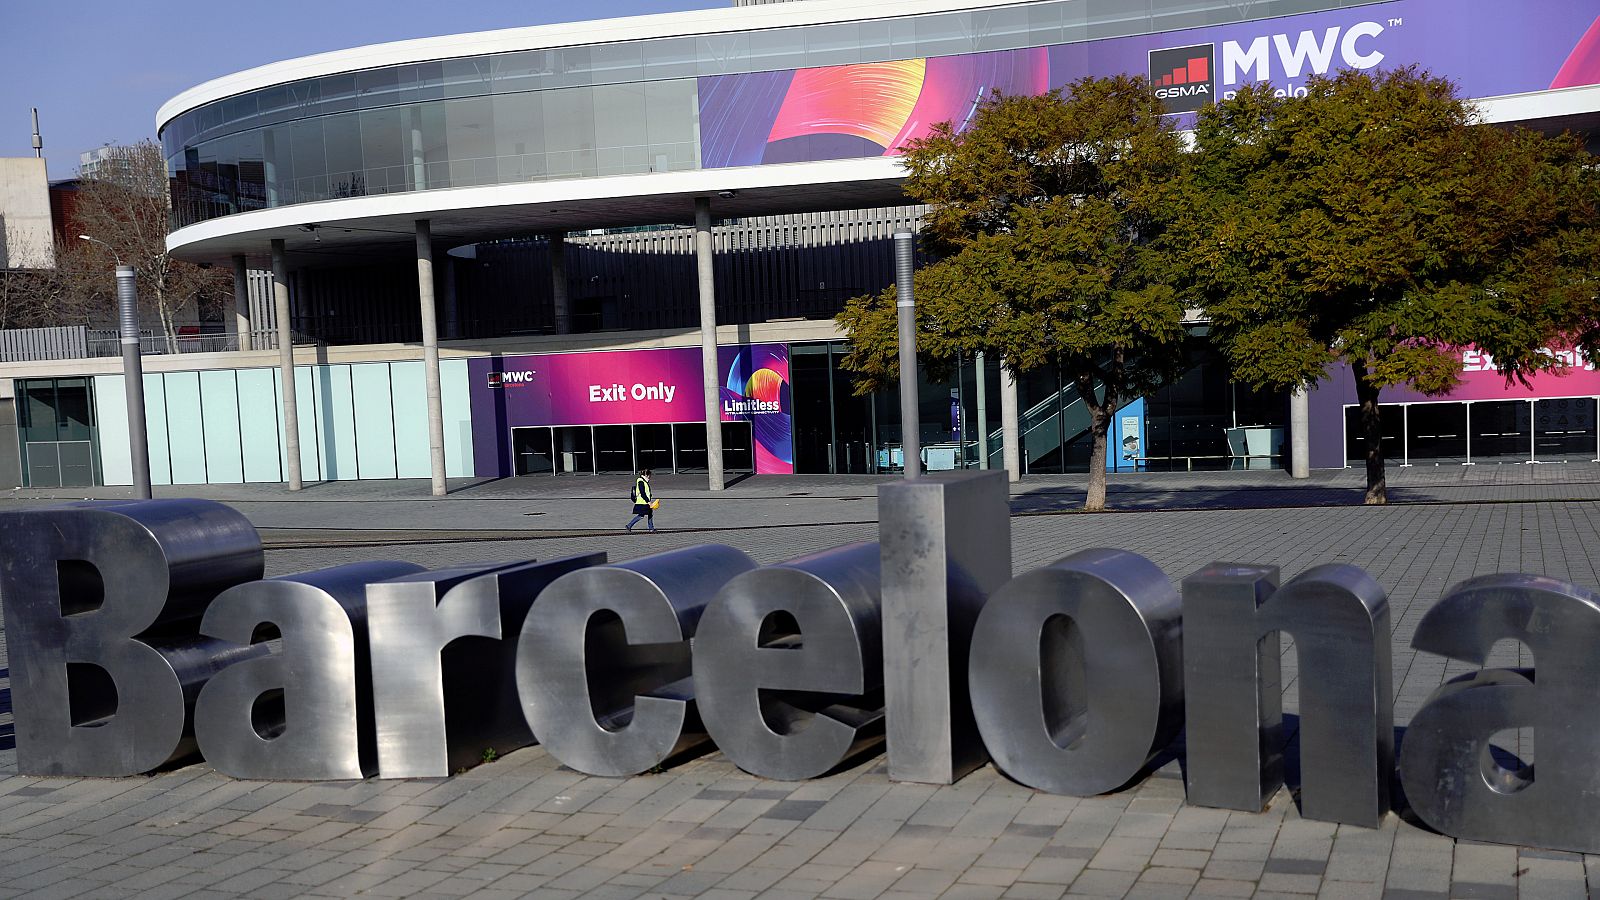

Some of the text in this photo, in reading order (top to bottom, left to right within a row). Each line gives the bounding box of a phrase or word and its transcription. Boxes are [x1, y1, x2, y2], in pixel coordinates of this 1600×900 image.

[1462, 348, 1520, 372] Ex
[589, 382, 676, 403] Exit Only
[724, 399, 780, 412] Limitless
[0, 472, 1600, 852] Barcelona
